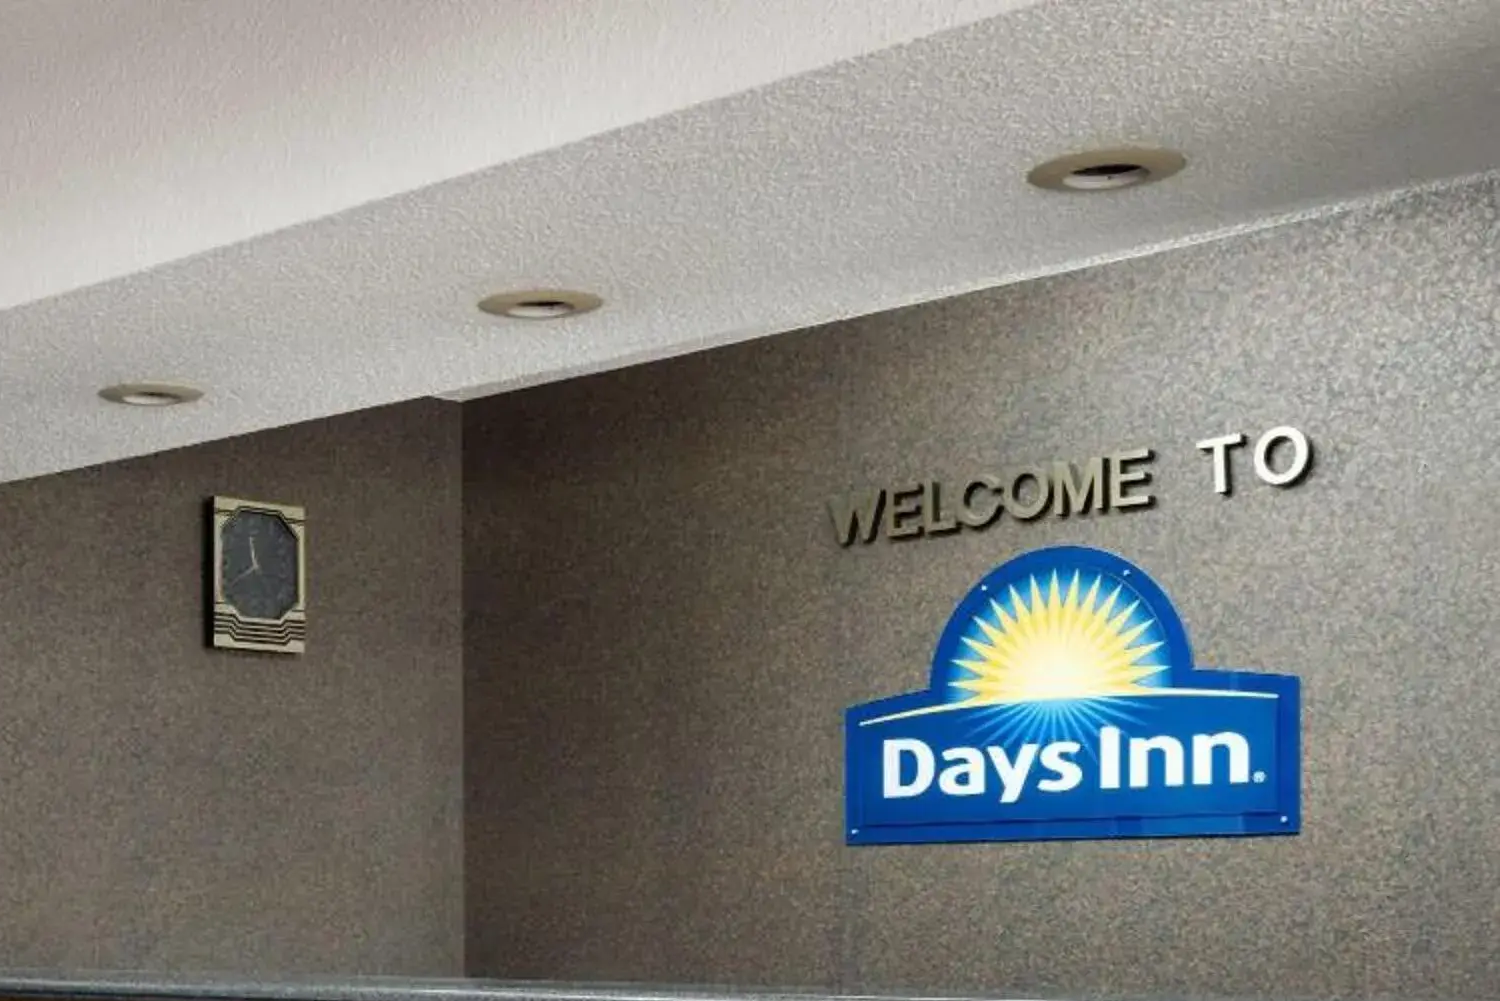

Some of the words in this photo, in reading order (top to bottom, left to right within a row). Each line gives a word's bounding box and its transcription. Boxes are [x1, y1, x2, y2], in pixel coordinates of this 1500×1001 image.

[827, 449, 1154, 546] WELCOME
[1196, 426, 1311, 495] TO
[883, 737, 1081, 803] Days
[1100, 726, 1250, 790] Inn
